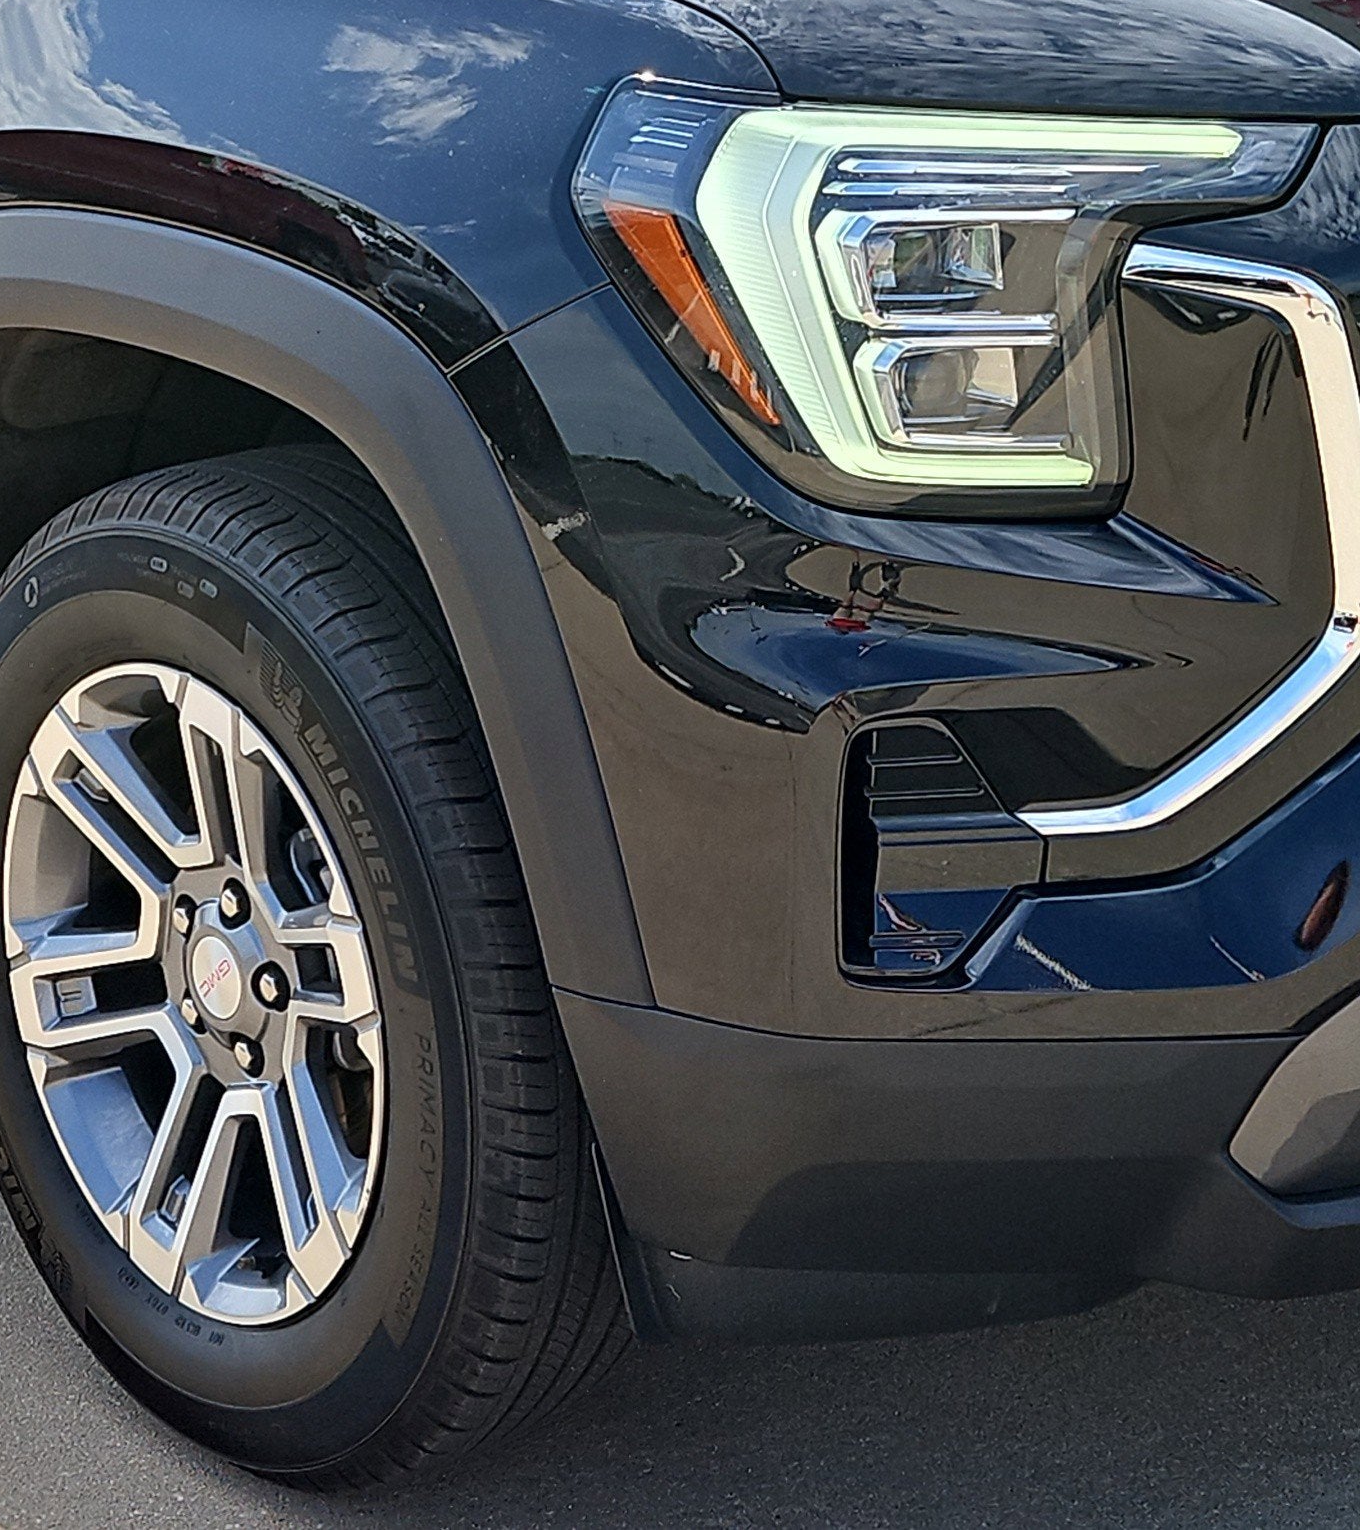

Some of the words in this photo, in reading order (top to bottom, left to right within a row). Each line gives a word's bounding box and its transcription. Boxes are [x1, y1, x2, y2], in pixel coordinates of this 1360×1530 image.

[304, 723, 418, 983] MICHELIN
[199, 959, 231, 998] GMC
[414, 1032, 437, 1189] PRIMACY
